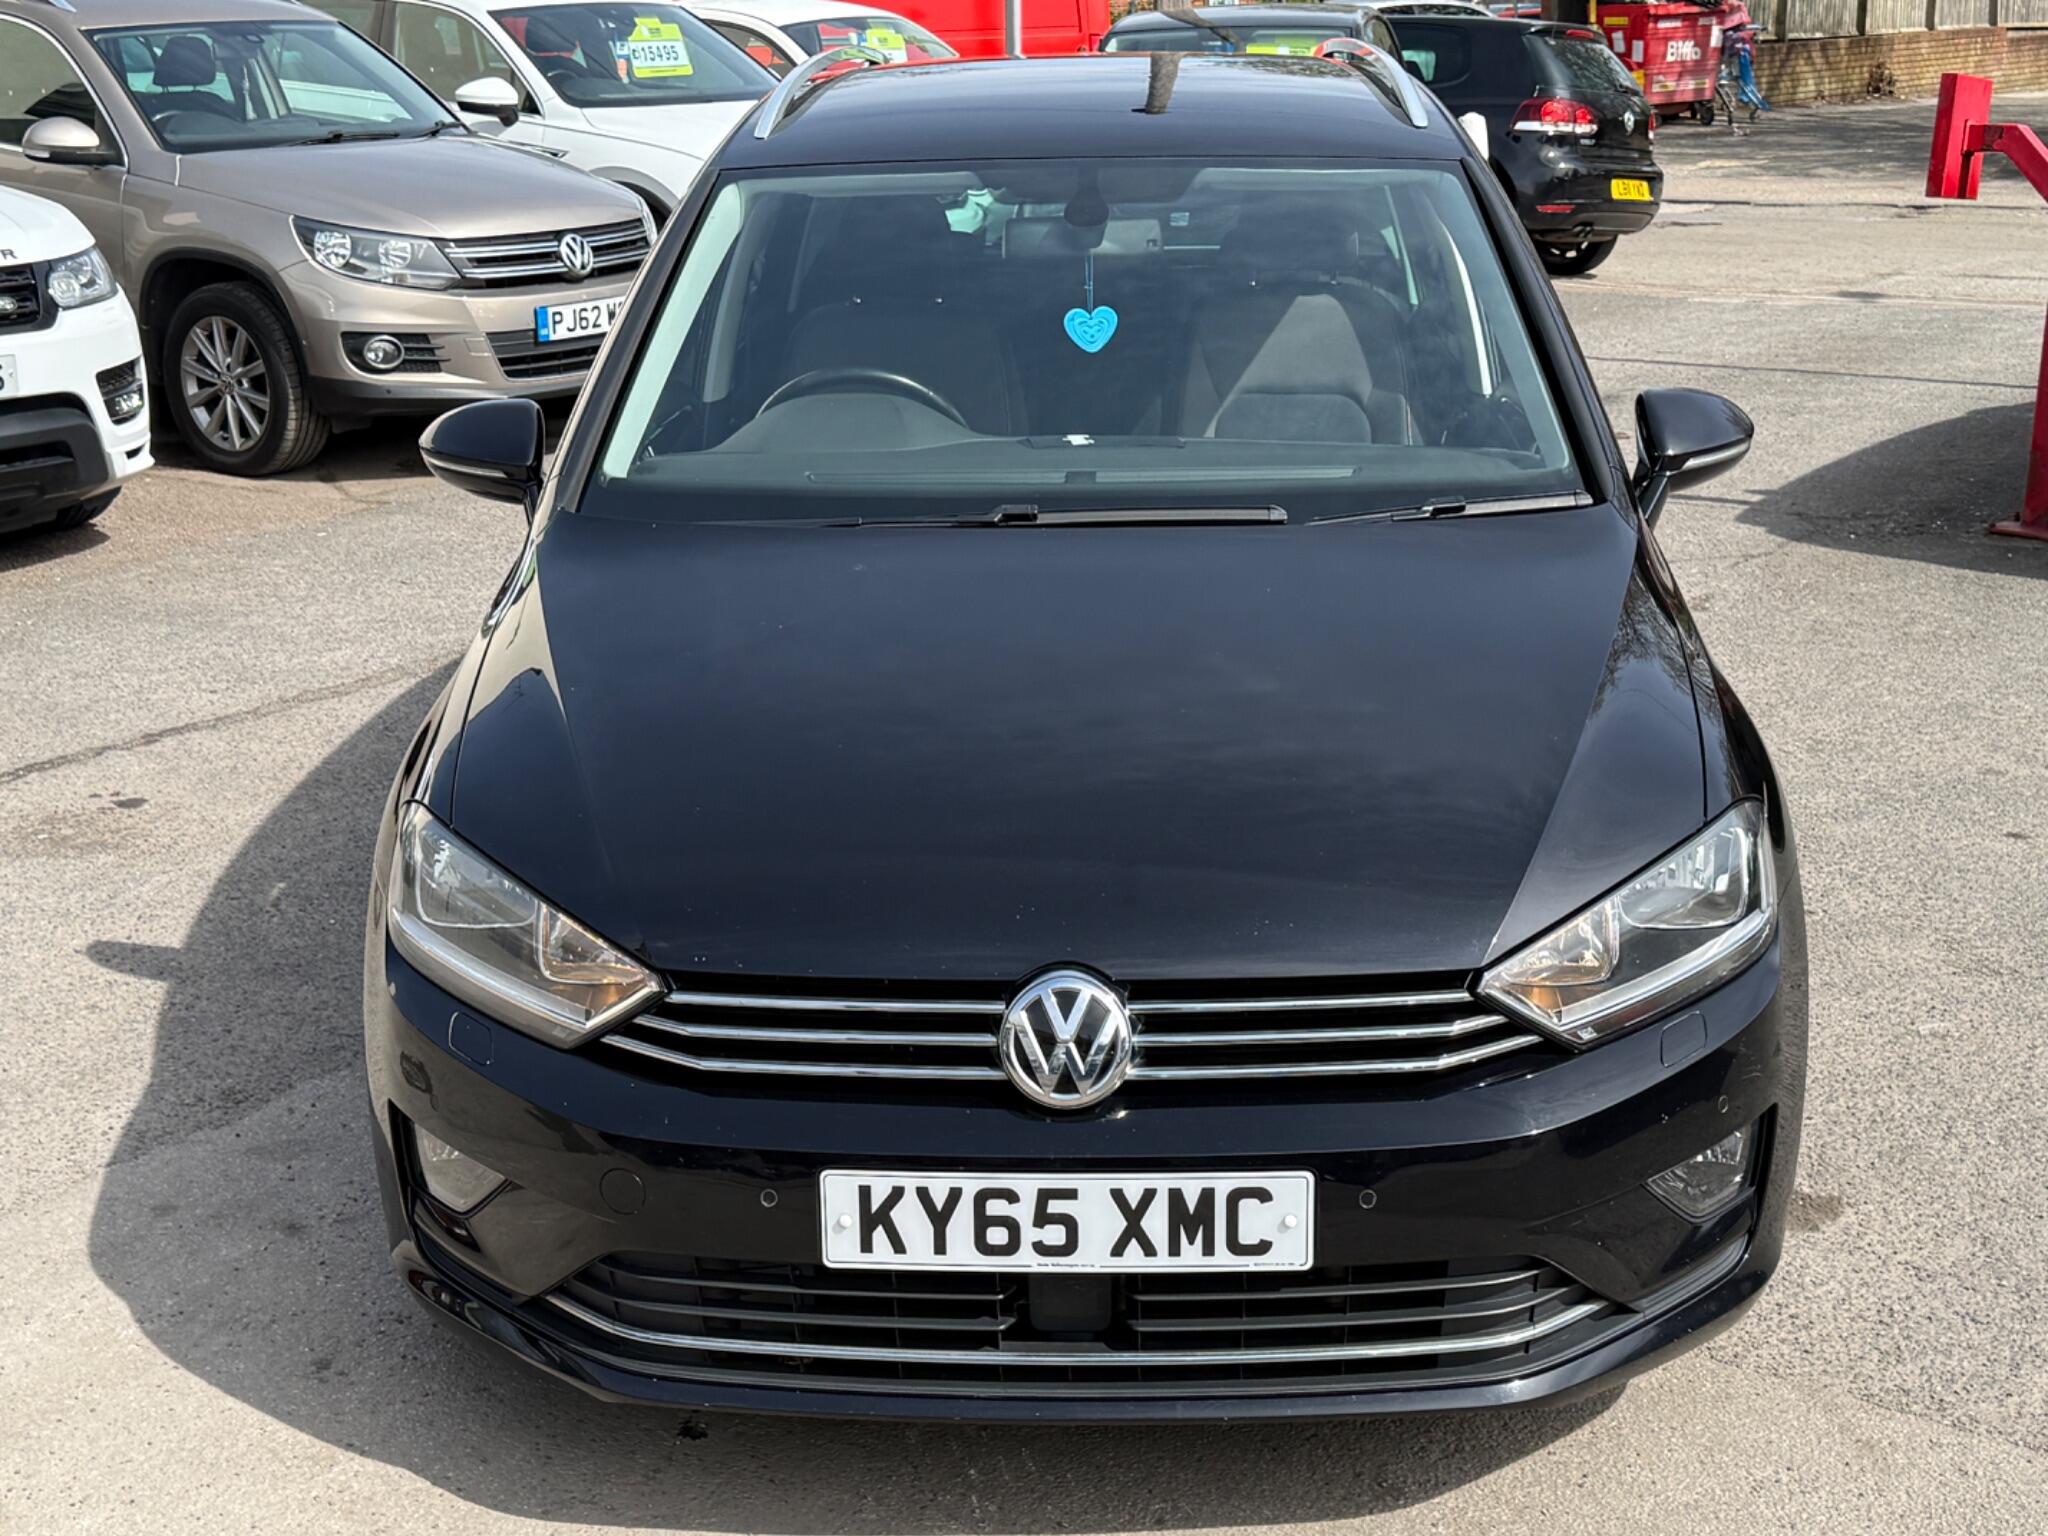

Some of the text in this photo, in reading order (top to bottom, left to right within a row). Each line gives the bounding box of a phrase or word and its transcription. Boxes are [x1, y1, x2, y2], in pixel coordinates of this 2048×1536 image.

[551, 305, 602, 335] PJ62
[858, 1185, 1273, 1257] KY65 XMC
